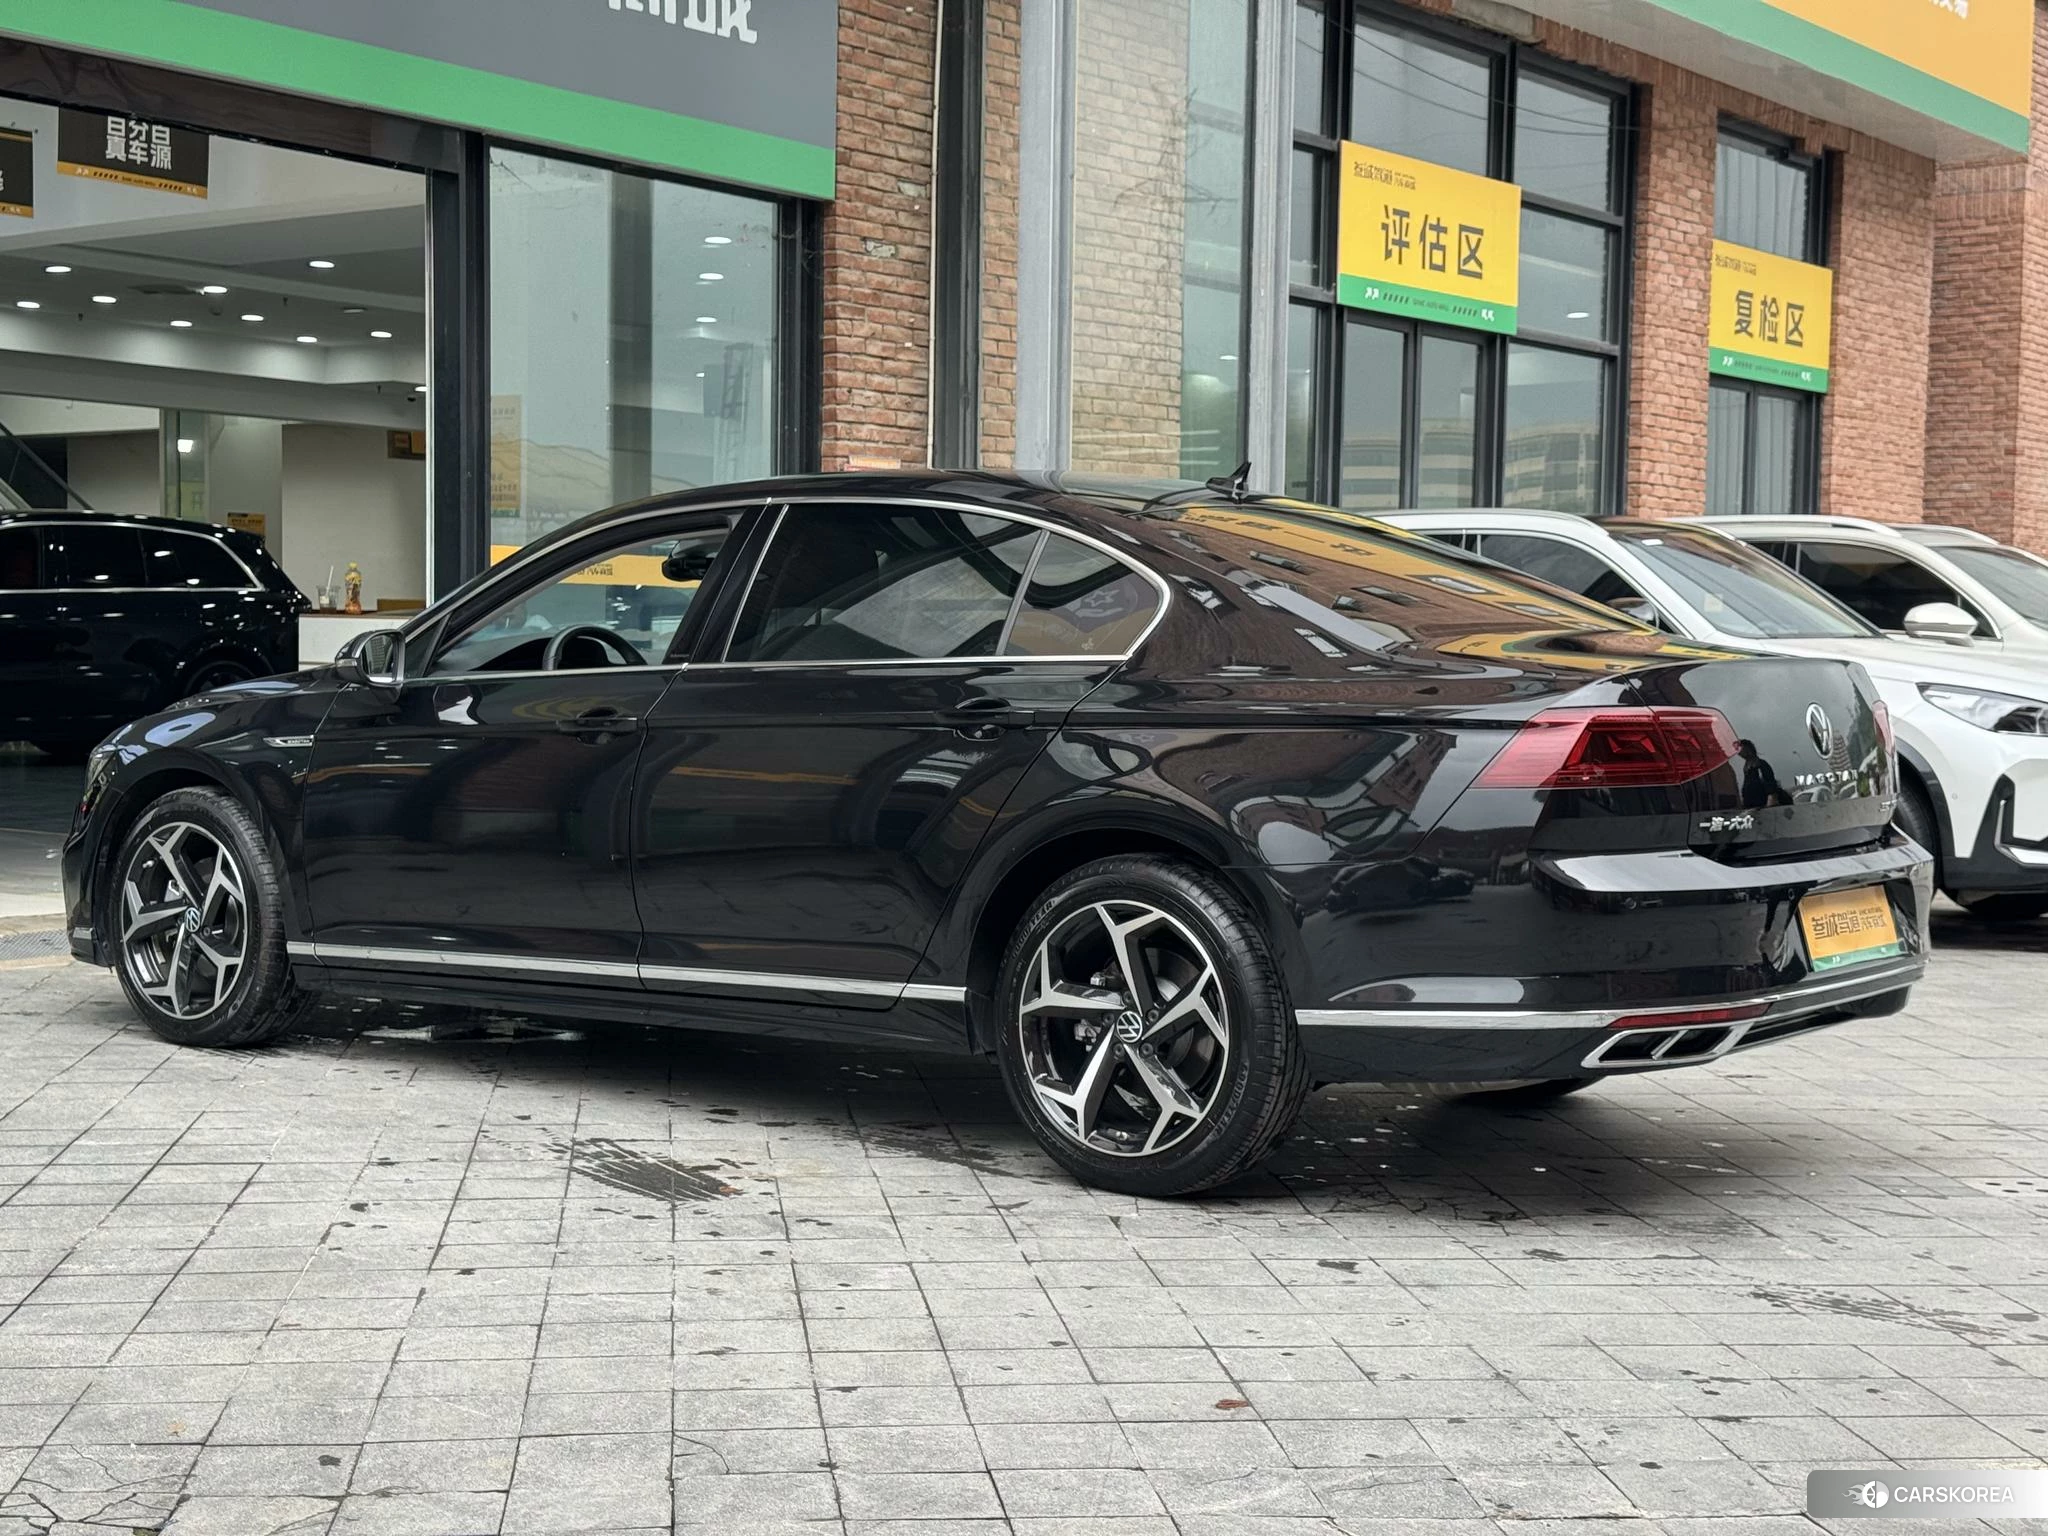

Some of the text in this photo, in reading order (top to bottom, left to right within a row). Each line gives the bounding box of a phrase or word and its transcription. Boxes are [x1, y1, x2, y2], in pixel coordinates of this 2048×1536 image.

[105, 136, 172, 170] 真车源
[1381, 204, 1484, 280] 评估区
[1734, 290, 1804, 348] 复检区
